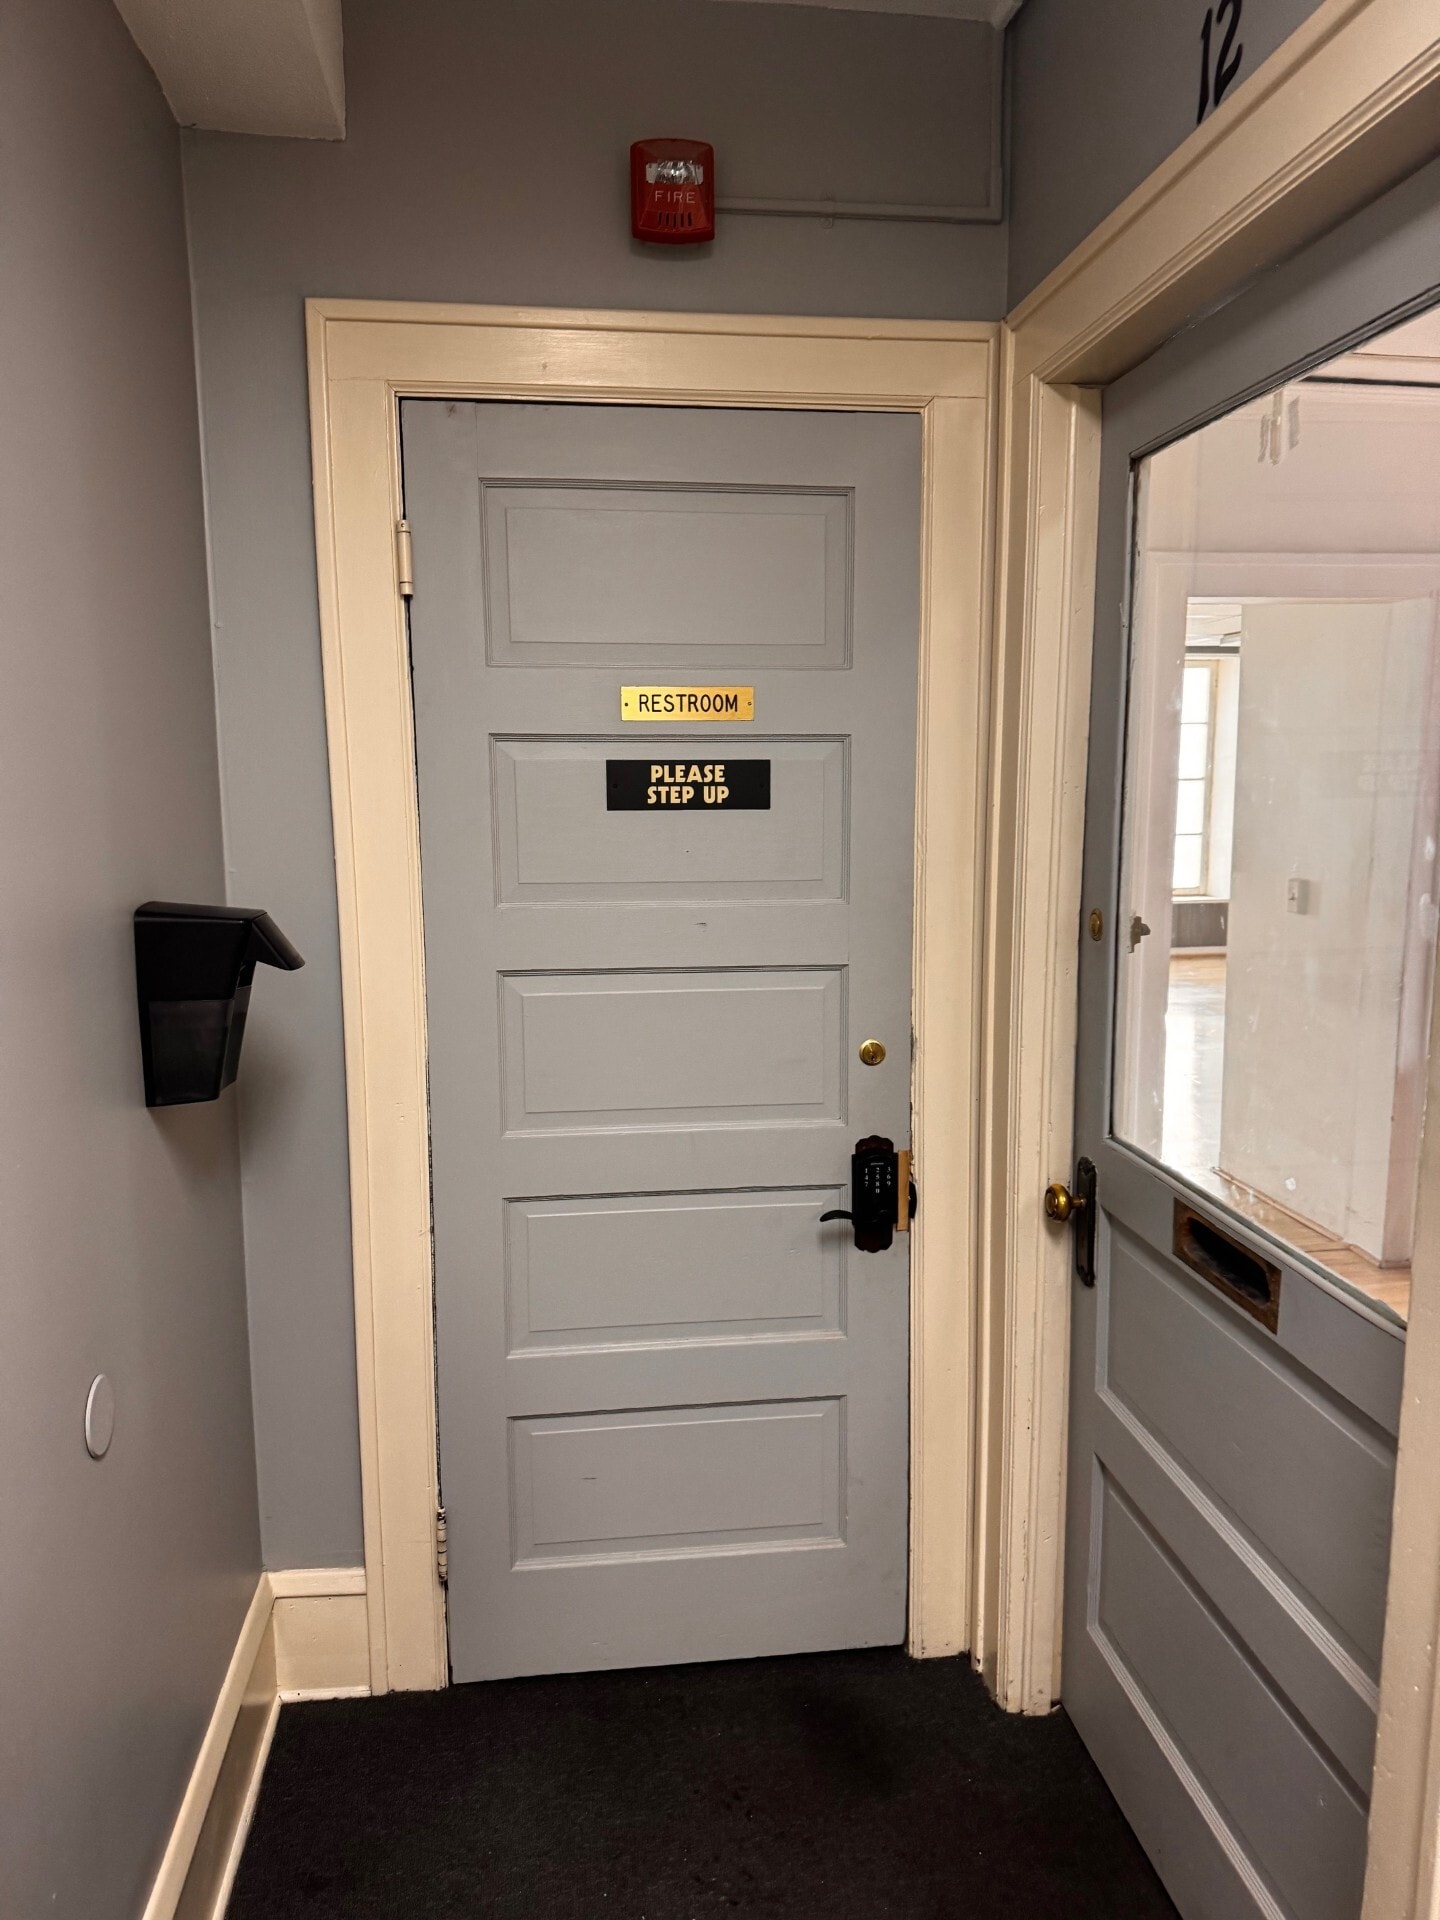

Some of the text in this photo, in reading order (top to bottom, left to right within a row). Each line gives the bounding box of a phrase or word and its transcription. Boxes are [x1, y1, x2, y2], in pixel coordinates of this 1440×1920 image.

[1196, 0, 1243, 125] 12
[655, 190, 696, 204] FIRE
[639, 694, 738, 712] RESTROOM
[650, 764, 725, 783] PLEASE
[647, 785, 730, 804] STEP UP
